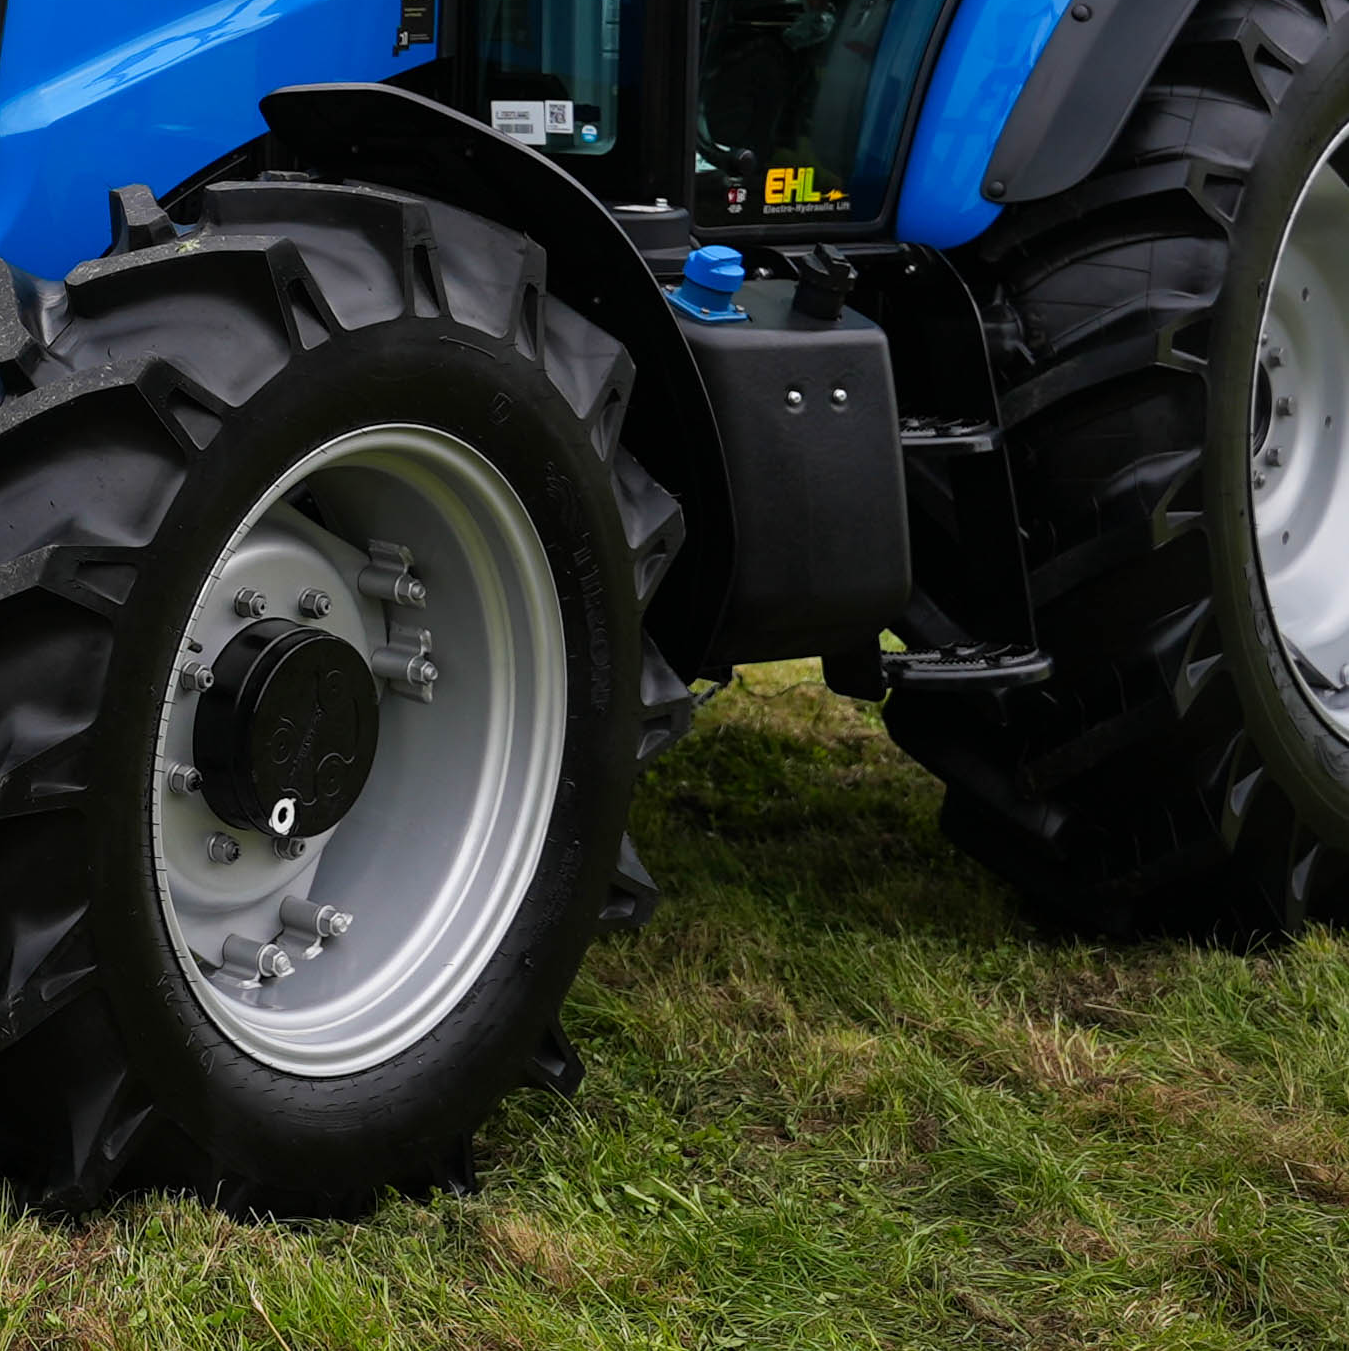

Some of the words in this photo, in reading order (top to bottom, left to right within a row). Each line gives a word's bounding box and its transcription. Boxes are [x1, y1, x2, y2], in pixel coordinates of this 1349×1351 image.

[765, 167, 821, 204] EHL
[763, 203, 834, 214] Electro-Hydraulic
[836, 201, 851, 210] Lift
